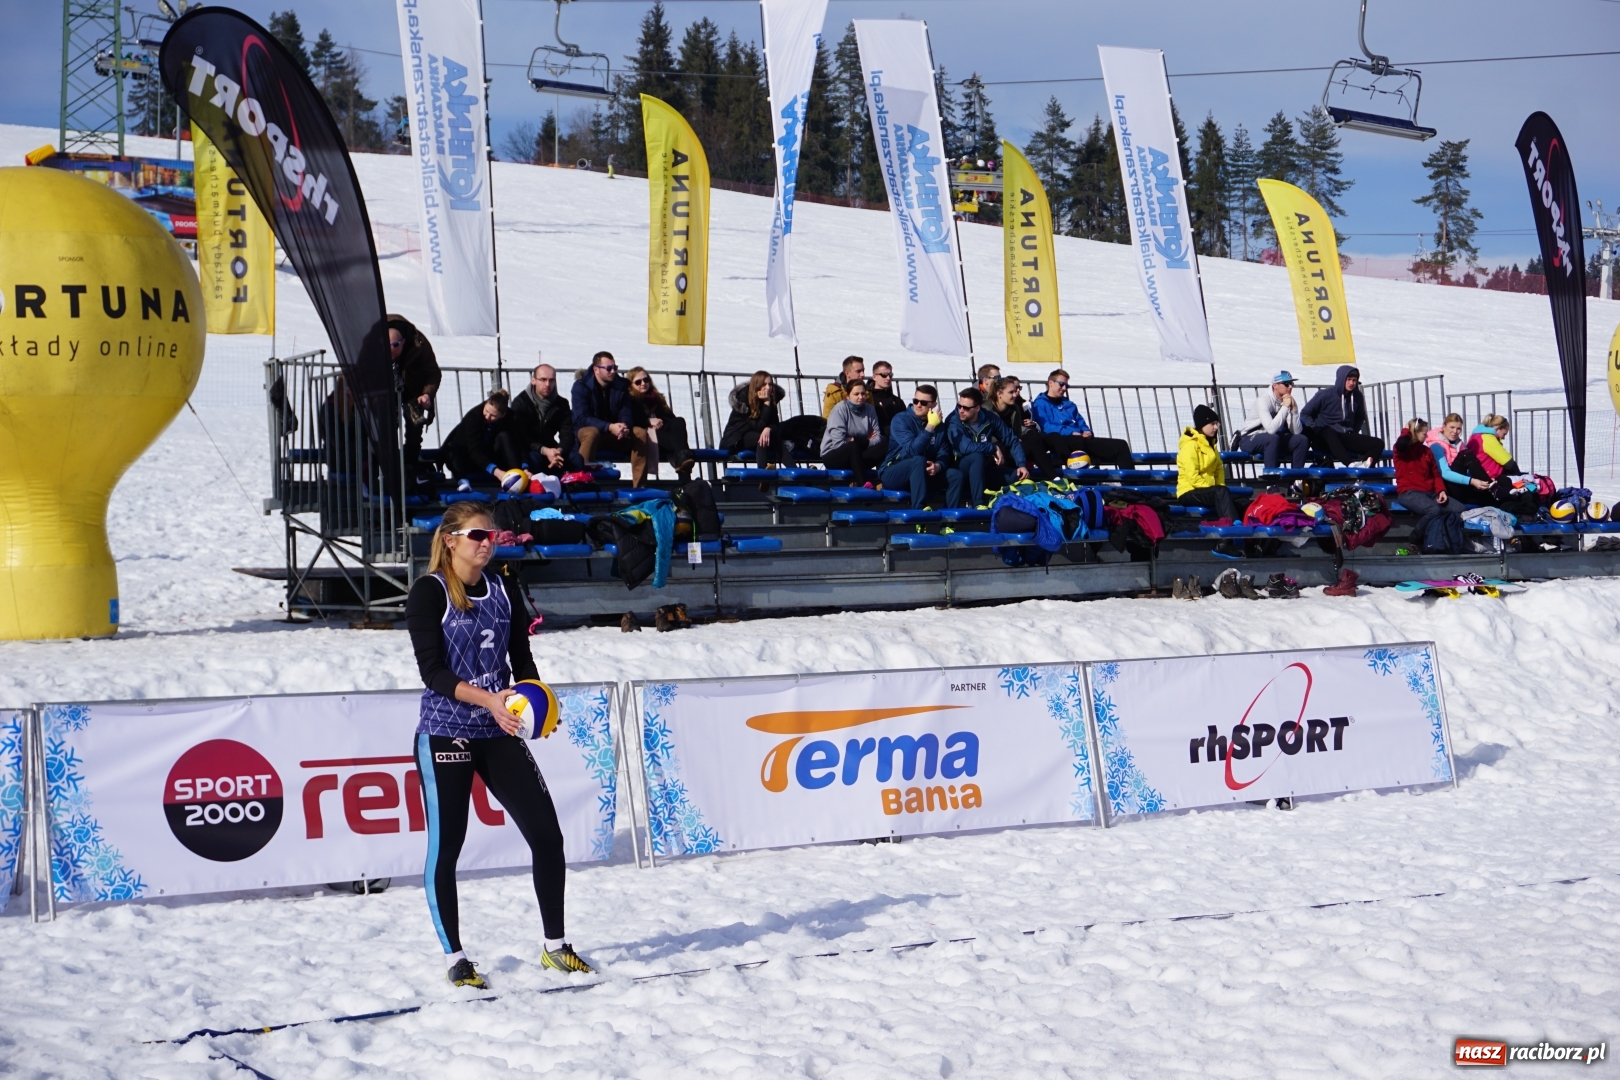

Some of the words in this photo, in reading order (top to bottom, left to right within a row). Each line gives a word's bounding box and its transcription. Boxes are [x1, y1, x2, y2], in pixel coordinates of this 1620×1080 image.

[0, 284, 190, 323] RTUNA
[100, 336, 178, 358] online
[480, 629, 495, 649] 2
[950, 682, 987, 692] PARTNER
[745, 705, 980, 793] Terma
[1189, 716, 1350, 763] rhSPORT
[437, 753, 471, 762] ORLEN
[174, 774, 272, 800] SPORT
[184, 800, 265, 826] 2000
